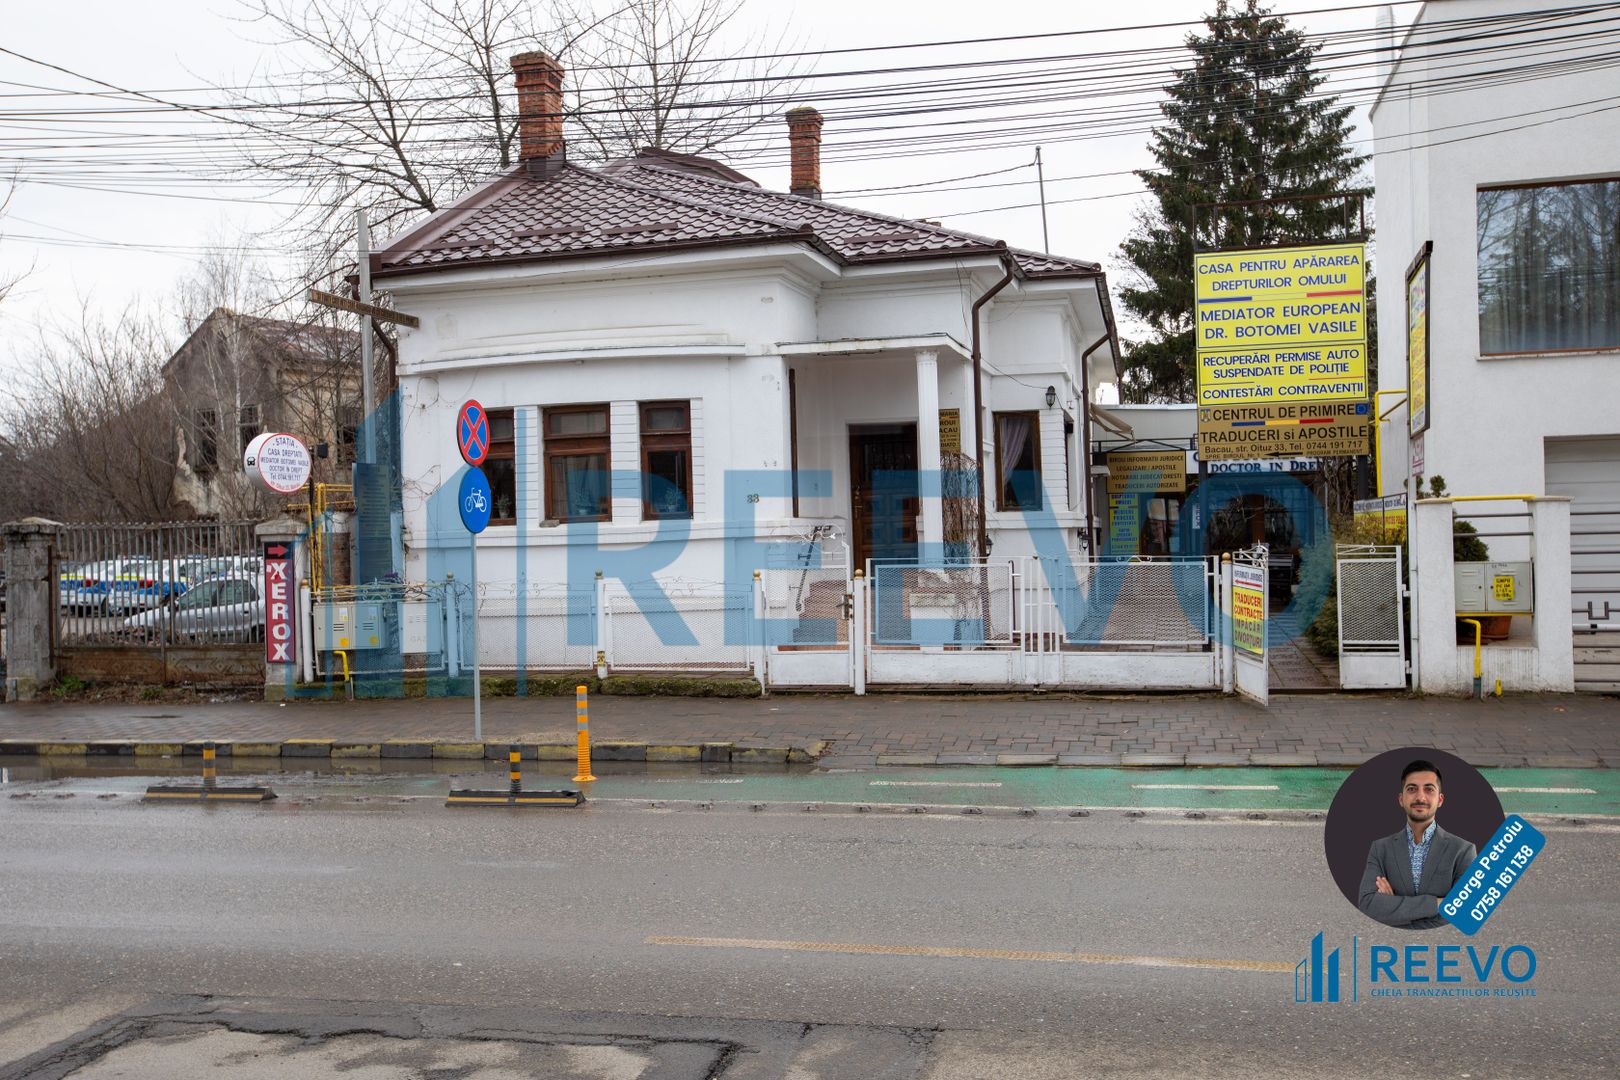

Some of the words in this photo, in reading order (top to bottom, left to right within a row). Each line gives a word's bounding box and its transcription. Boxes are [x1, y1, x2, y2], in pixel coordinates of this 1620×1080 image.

[1199, 264, 1234, 274] CASA
[1240, 260, 1286, 272] PENTRU
[1293, 254, 1360, 268] APĂRAREA
[1212, 277, 1292, 292] DREPTURILOR
[1298, 274, 1346, 286] OMULUI
[1201, 307, 1274, 322] MEDIATOR
[1283, 302, 1360, 317] EUROPEAN
[1205, 328, 1228, 340] DR.
[1236, 324, 1300, 338] BOTOMEI
[1308, 320, 1357, 334] VASILE
[1203, 352, 1270, 366] RECUPERĂRI
[1276, 351, 1322, 362] PERMISE
[1326, 349, 1360, 360] AUTO
[1214, 366, 1284, 378] SUSPENDATE
[1290, 365, 1304, 374] DE
[1310, 362, 1350, 376] POLIȚIE
[1202, 385, 1273, 400] CONTESTĂRI
[1278, 382, 1364, 396] CONTRAVENȚII
[1213, 406, 1275, 420] CENTRUL
[1278, 406, 1296, 418] DE
[1300, 403, 1356, 416] PRIMIRE
[1200, 429, 1280, 443] TRADUCERI
[1284, 428, 1295, 440] si
[1299, 426, 1368, 440] APOSTILE
[268, 448, 280, 456] CASA
[1204, 445, 1234, 454] Bacau,
[1236, 444, 1248, 452] str.
[1250, 444, 1272, 452] Oituz
[1289, 442, 1304, 450] Tel.
[1306, 442, 1327, 450] 0744
[1330, 440, 1344, 449] 191
[1348, 440, 1363, 448] 717
[1210, 462, 1262, 474] DOCTOR
[1270, 462, 1284, 472] IN
[1234, 592, 1262, 608] TRADUCERI
[270, 561, 291, 661] XEROX
[1234, 605, 1262, 620] CONTRACTE
